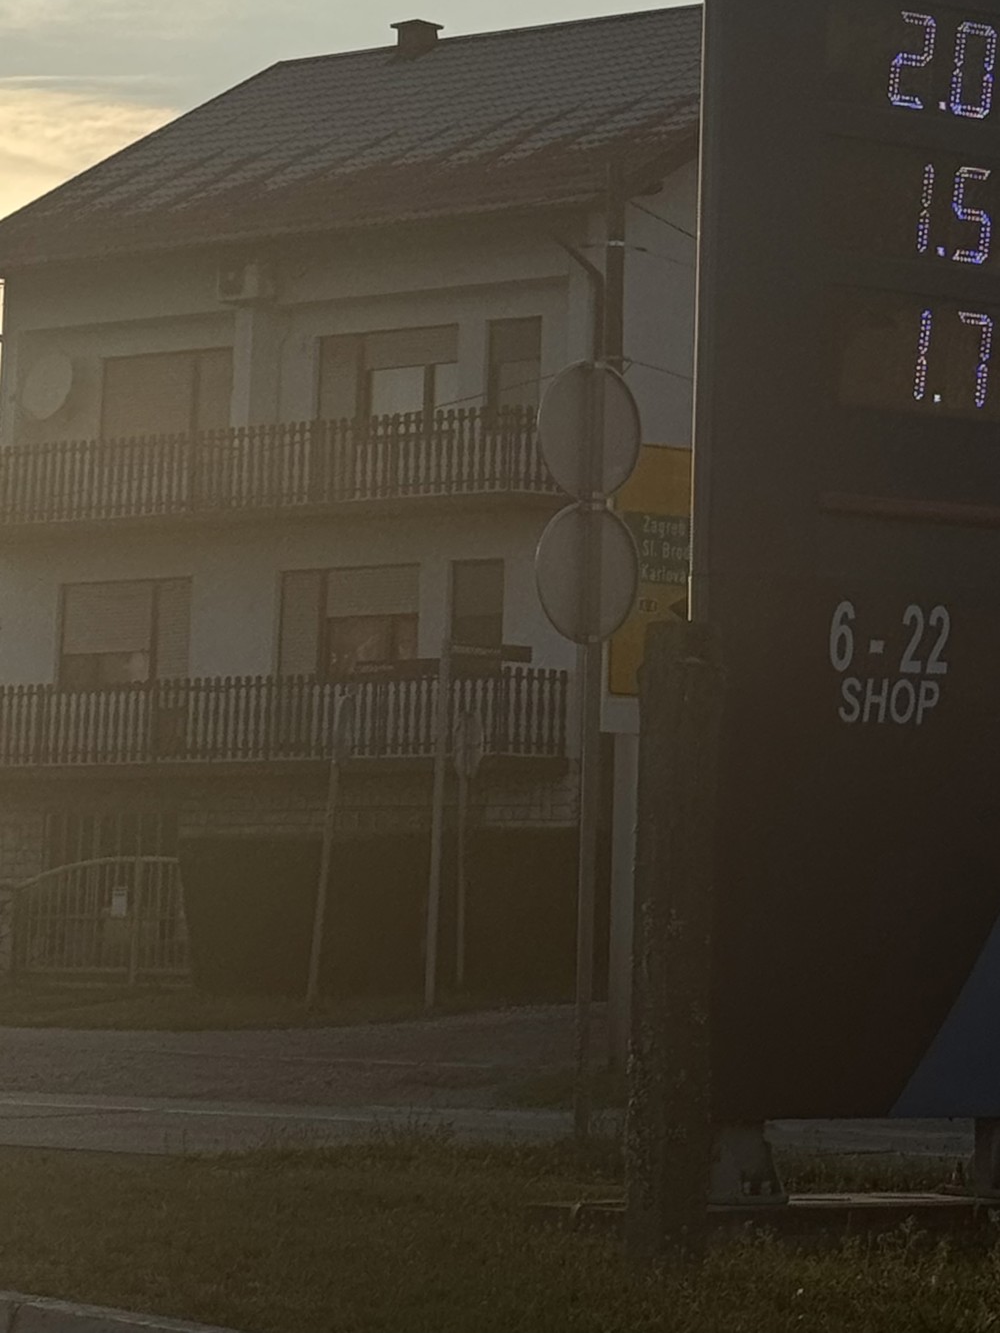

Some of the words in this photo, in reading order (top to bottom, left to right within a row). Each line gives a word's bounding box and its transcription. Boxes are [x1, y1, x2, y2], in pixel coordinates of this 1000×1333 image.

[643, 515, 687, 538] Zagreb
[641, 563, 687, 584] Karlova
[829, 600, 856, 672] 6
[899, 604, 951, 675] 22
[838, 677, 940, 725] SHOP
